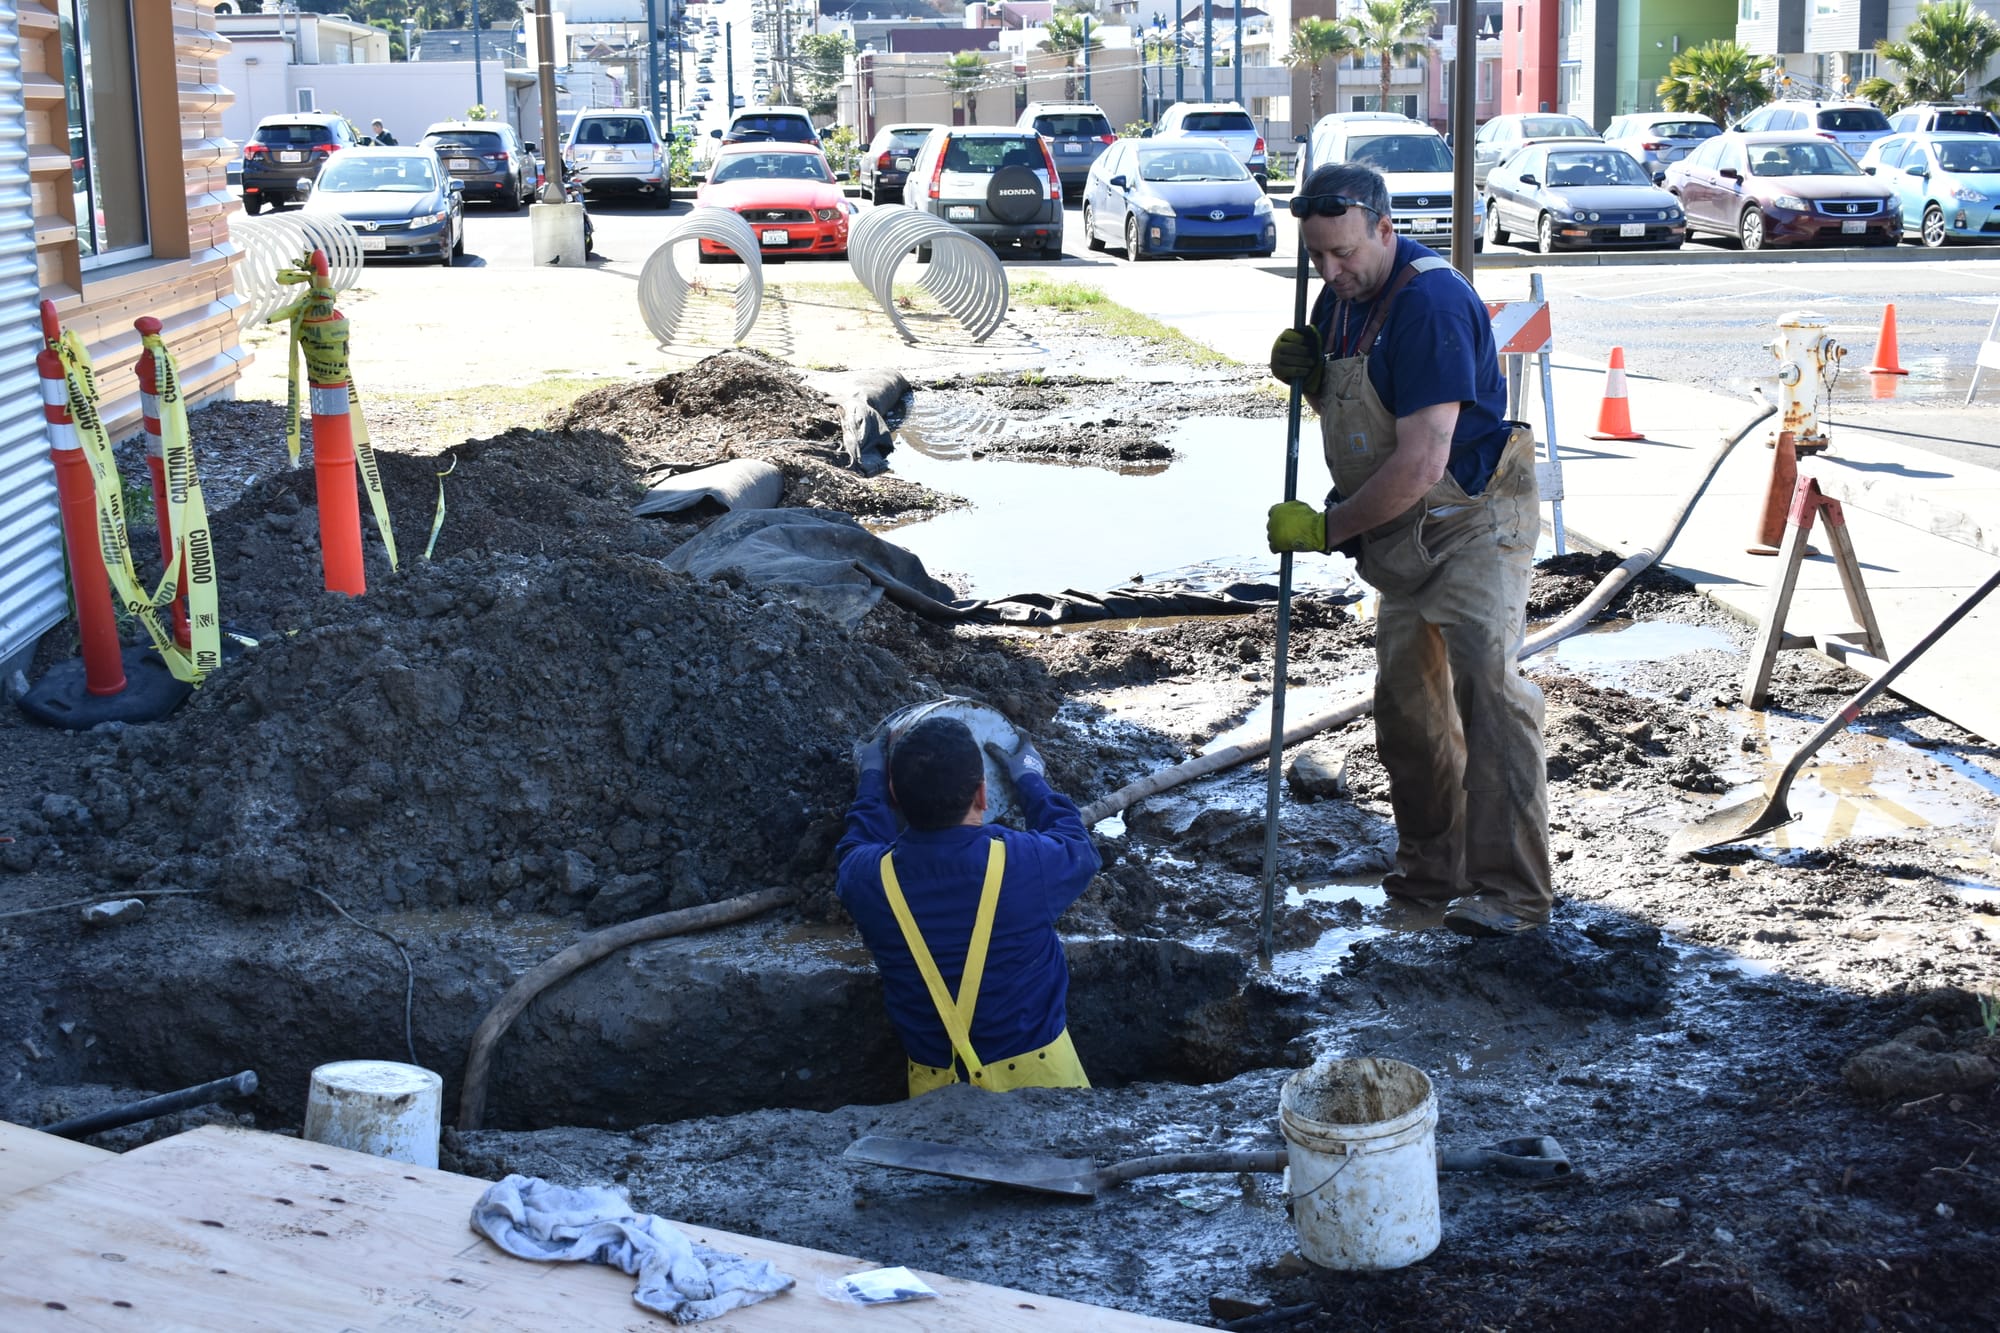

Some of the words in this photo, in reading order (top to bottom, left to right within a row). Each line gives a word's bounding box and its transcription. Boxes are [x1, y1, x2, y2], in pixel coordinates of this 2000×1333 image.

[999, 188, 1037, 196] HONDA
[67, 372, 94, 431] CUIDADO
[167, 446, 188, 504] CAUTION
[189, 528, 213, 585] CUIDADO
